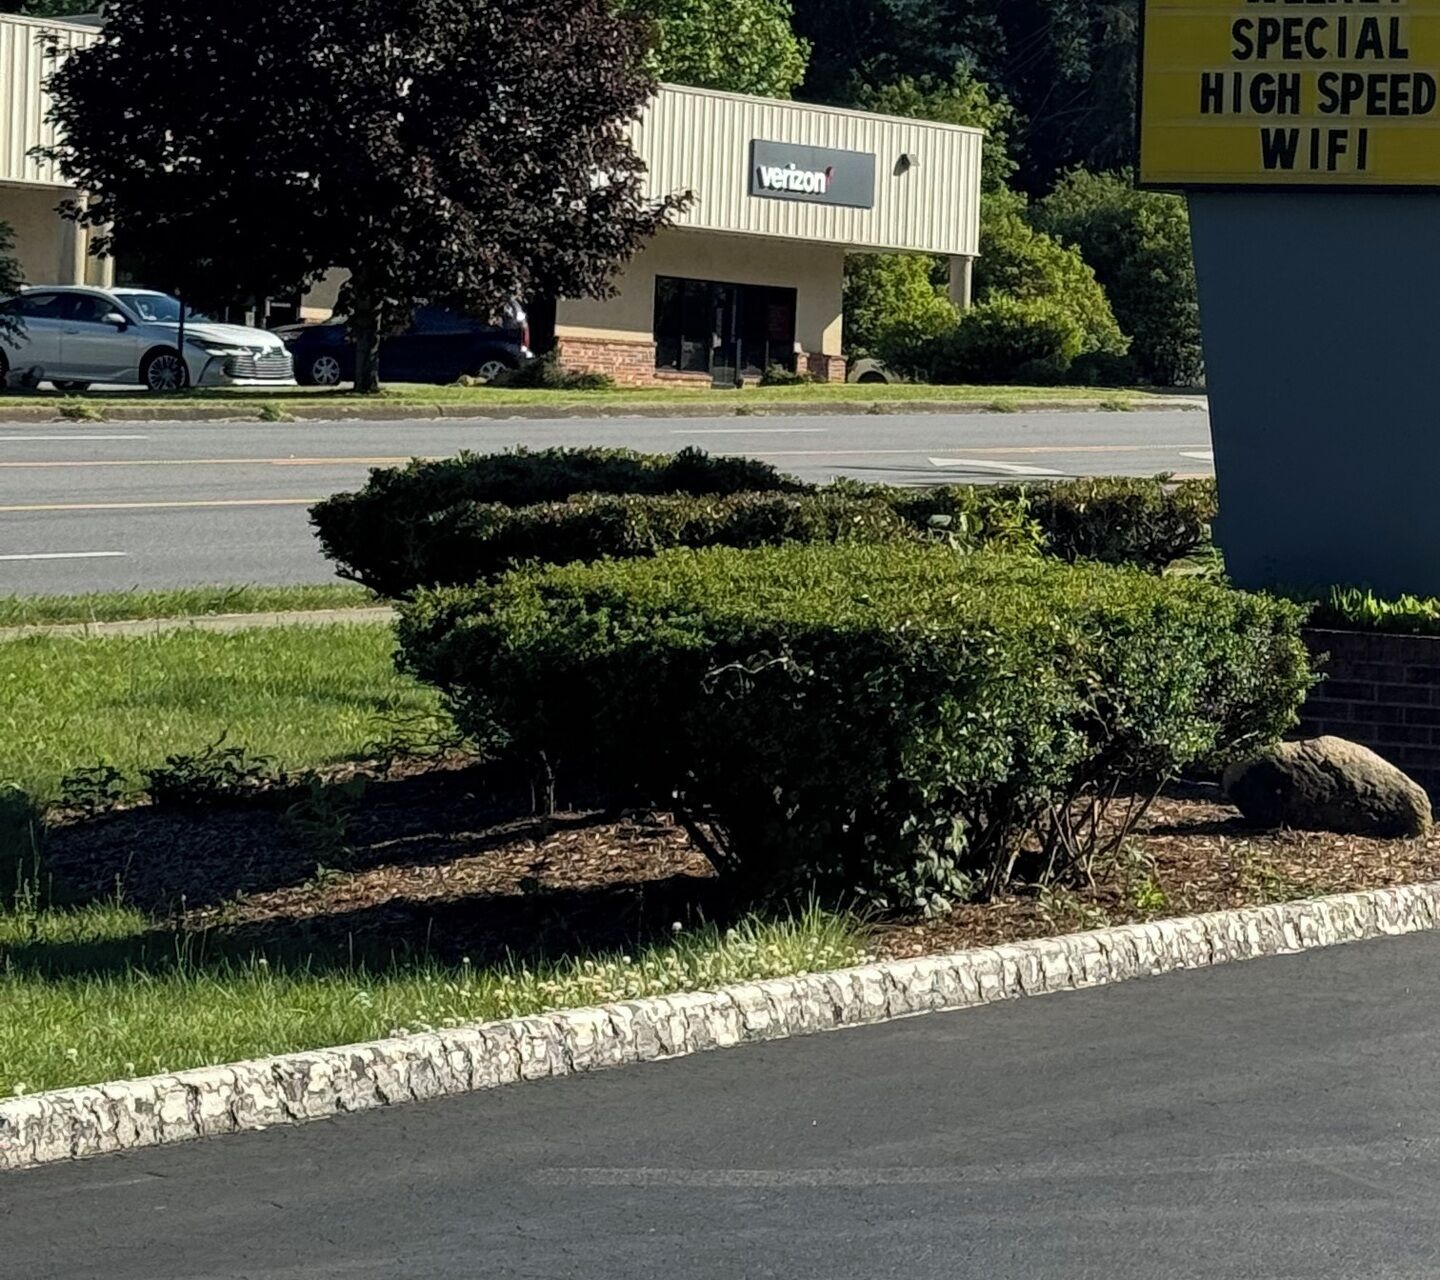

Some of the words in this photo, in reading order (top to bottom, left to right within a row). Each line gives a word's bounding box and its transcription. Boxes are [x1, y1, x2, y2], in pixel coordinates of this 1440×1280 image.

[1231, 16, 1409, 60] SPECIAL
[1201, 72, 1300, 114] HIGH
[1317, 71, 1437, 115] SPEED
[1261, 128, 1368, 171] WIFI
[760, 163, 827, 193] verizon
